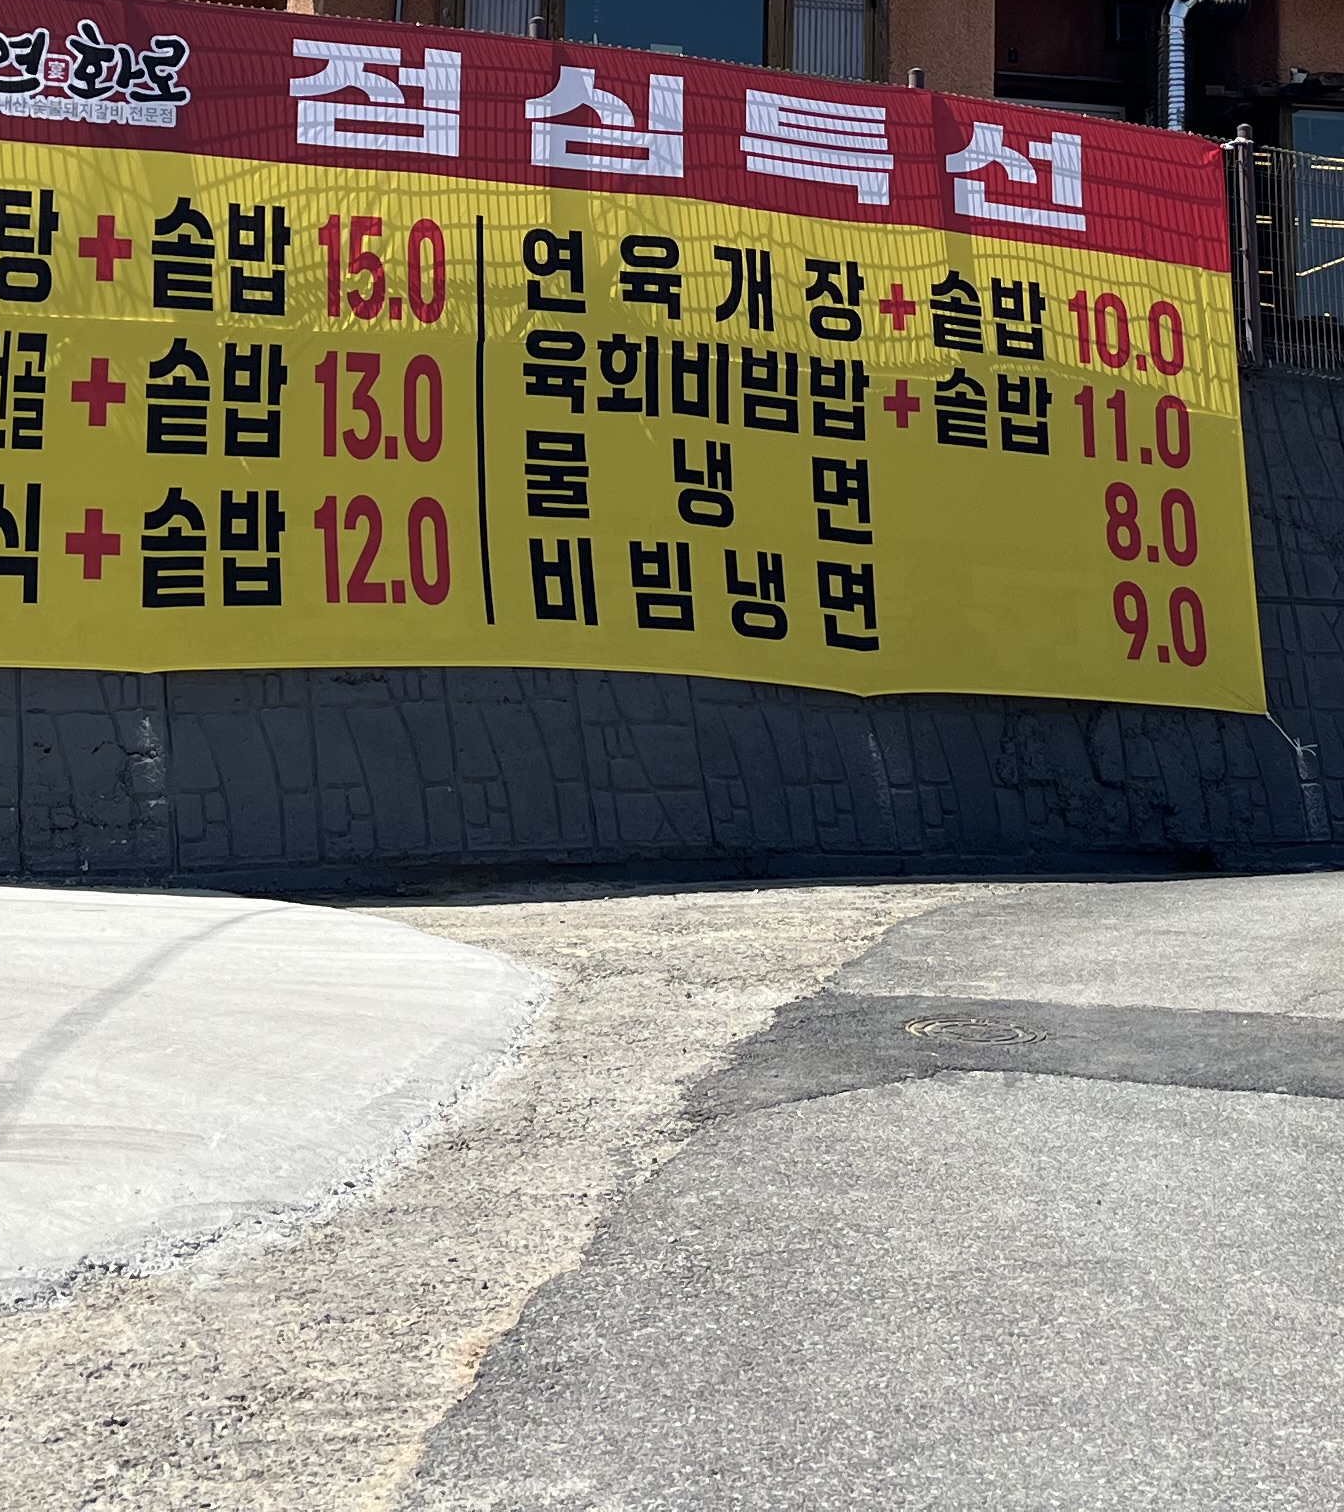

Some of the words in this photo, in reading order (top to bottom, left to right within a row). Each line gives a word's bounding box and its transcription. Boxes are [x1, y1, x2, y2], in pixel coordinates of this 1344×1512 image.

[31, 97, 125, 123] 숯불돼지갈비
[129, 105, 174, 125] 전문점
[290, 39, 1086, 231] 점심특선
[151, 196, 291, 317] 솥밥
[318, 214, 446, 324] 15.0
[522, 228, 865, 342] 연육개장
[930, 269, 1047, 362] 솥밥
[1068, 290, 1185, 376] 10.0
[145, 337, 288, 458] 솥밥
[316, 351, 442, 461] 13.0
[523, 329, 870, 443] 육회비빔밥
[934, 367, 1053, 456] 솥밥
[1074, 386, 1191, 470] 11.0
[140, 487, 286, 609] 솥밥
[315, 495, 450, 606] 12.0
[524, 430, 874, 546] 물냉면
[1105, 482, 1199, 568] 8.0
[529, 537, 880, 651] 비빔냉면
[1113, 580, 1207, 667] 9.0
